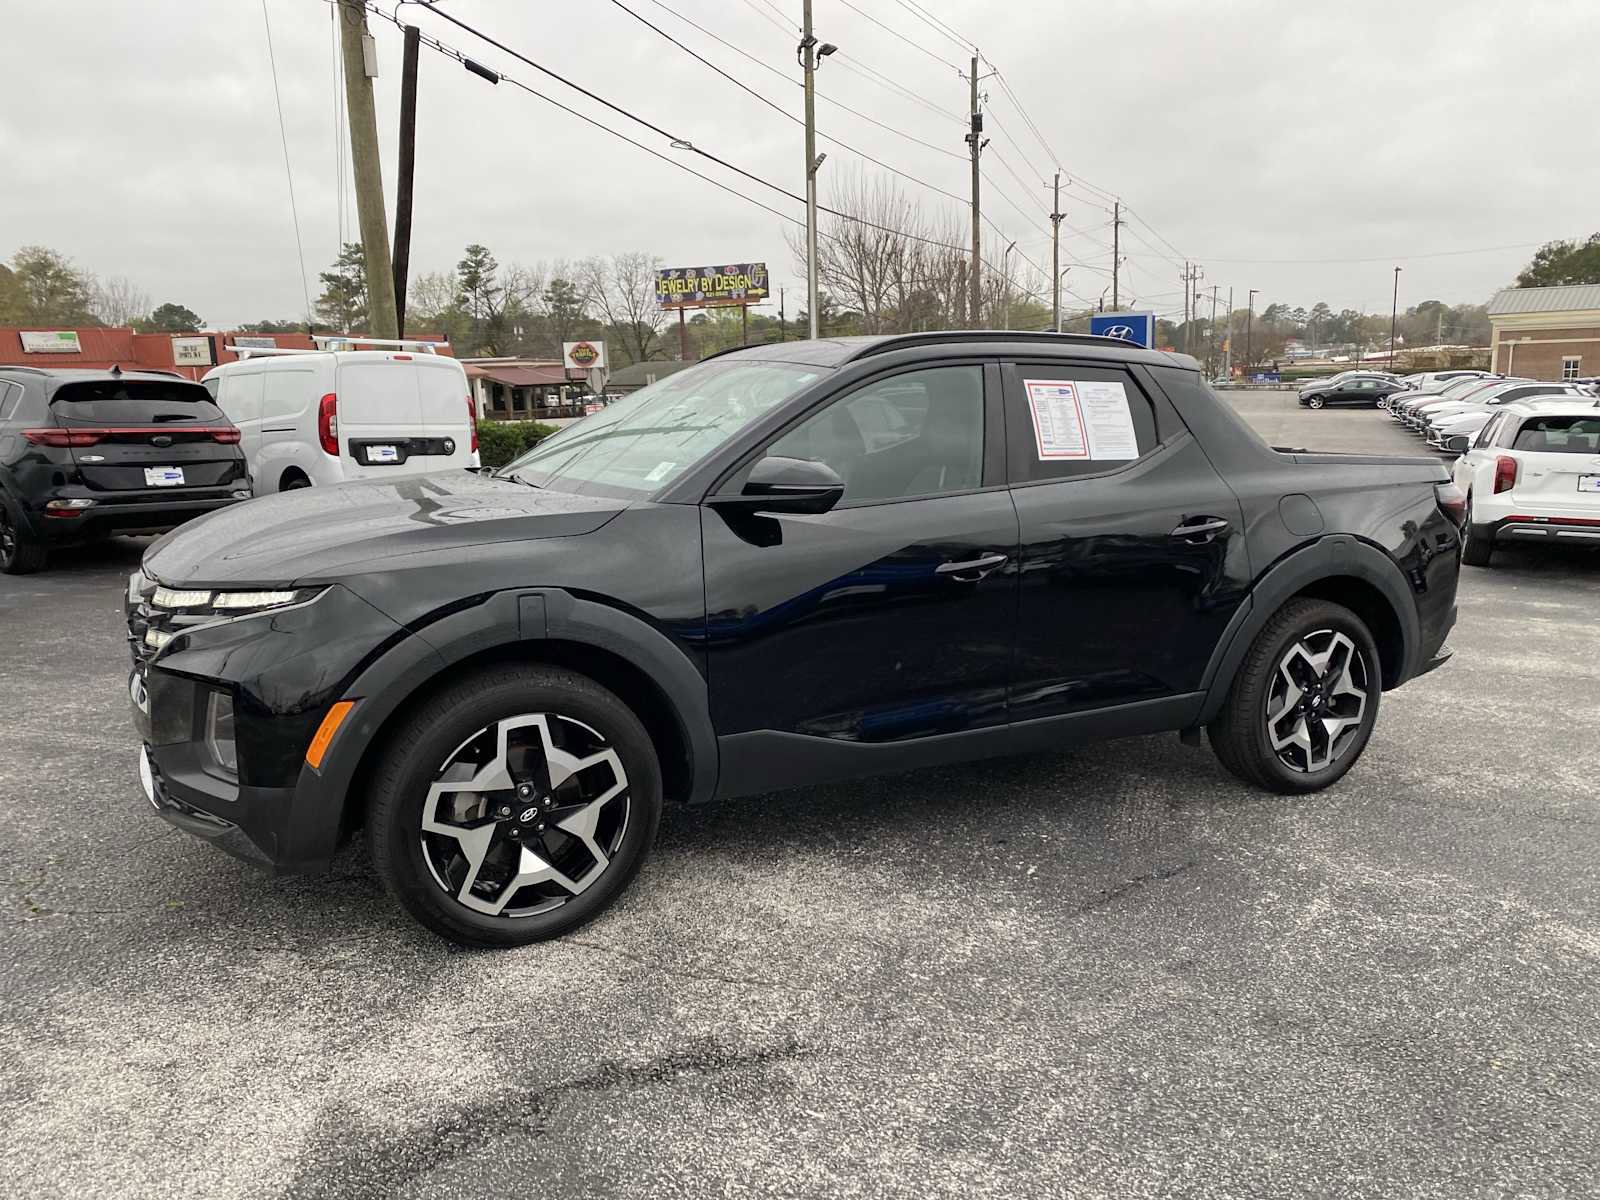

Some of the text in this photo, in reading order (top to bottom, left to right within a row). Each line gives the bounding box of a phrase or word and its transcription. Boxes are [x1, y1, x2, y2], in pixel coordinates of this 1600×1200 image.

[656, 274, 753, 294] JEWELRY BY DESIGN
